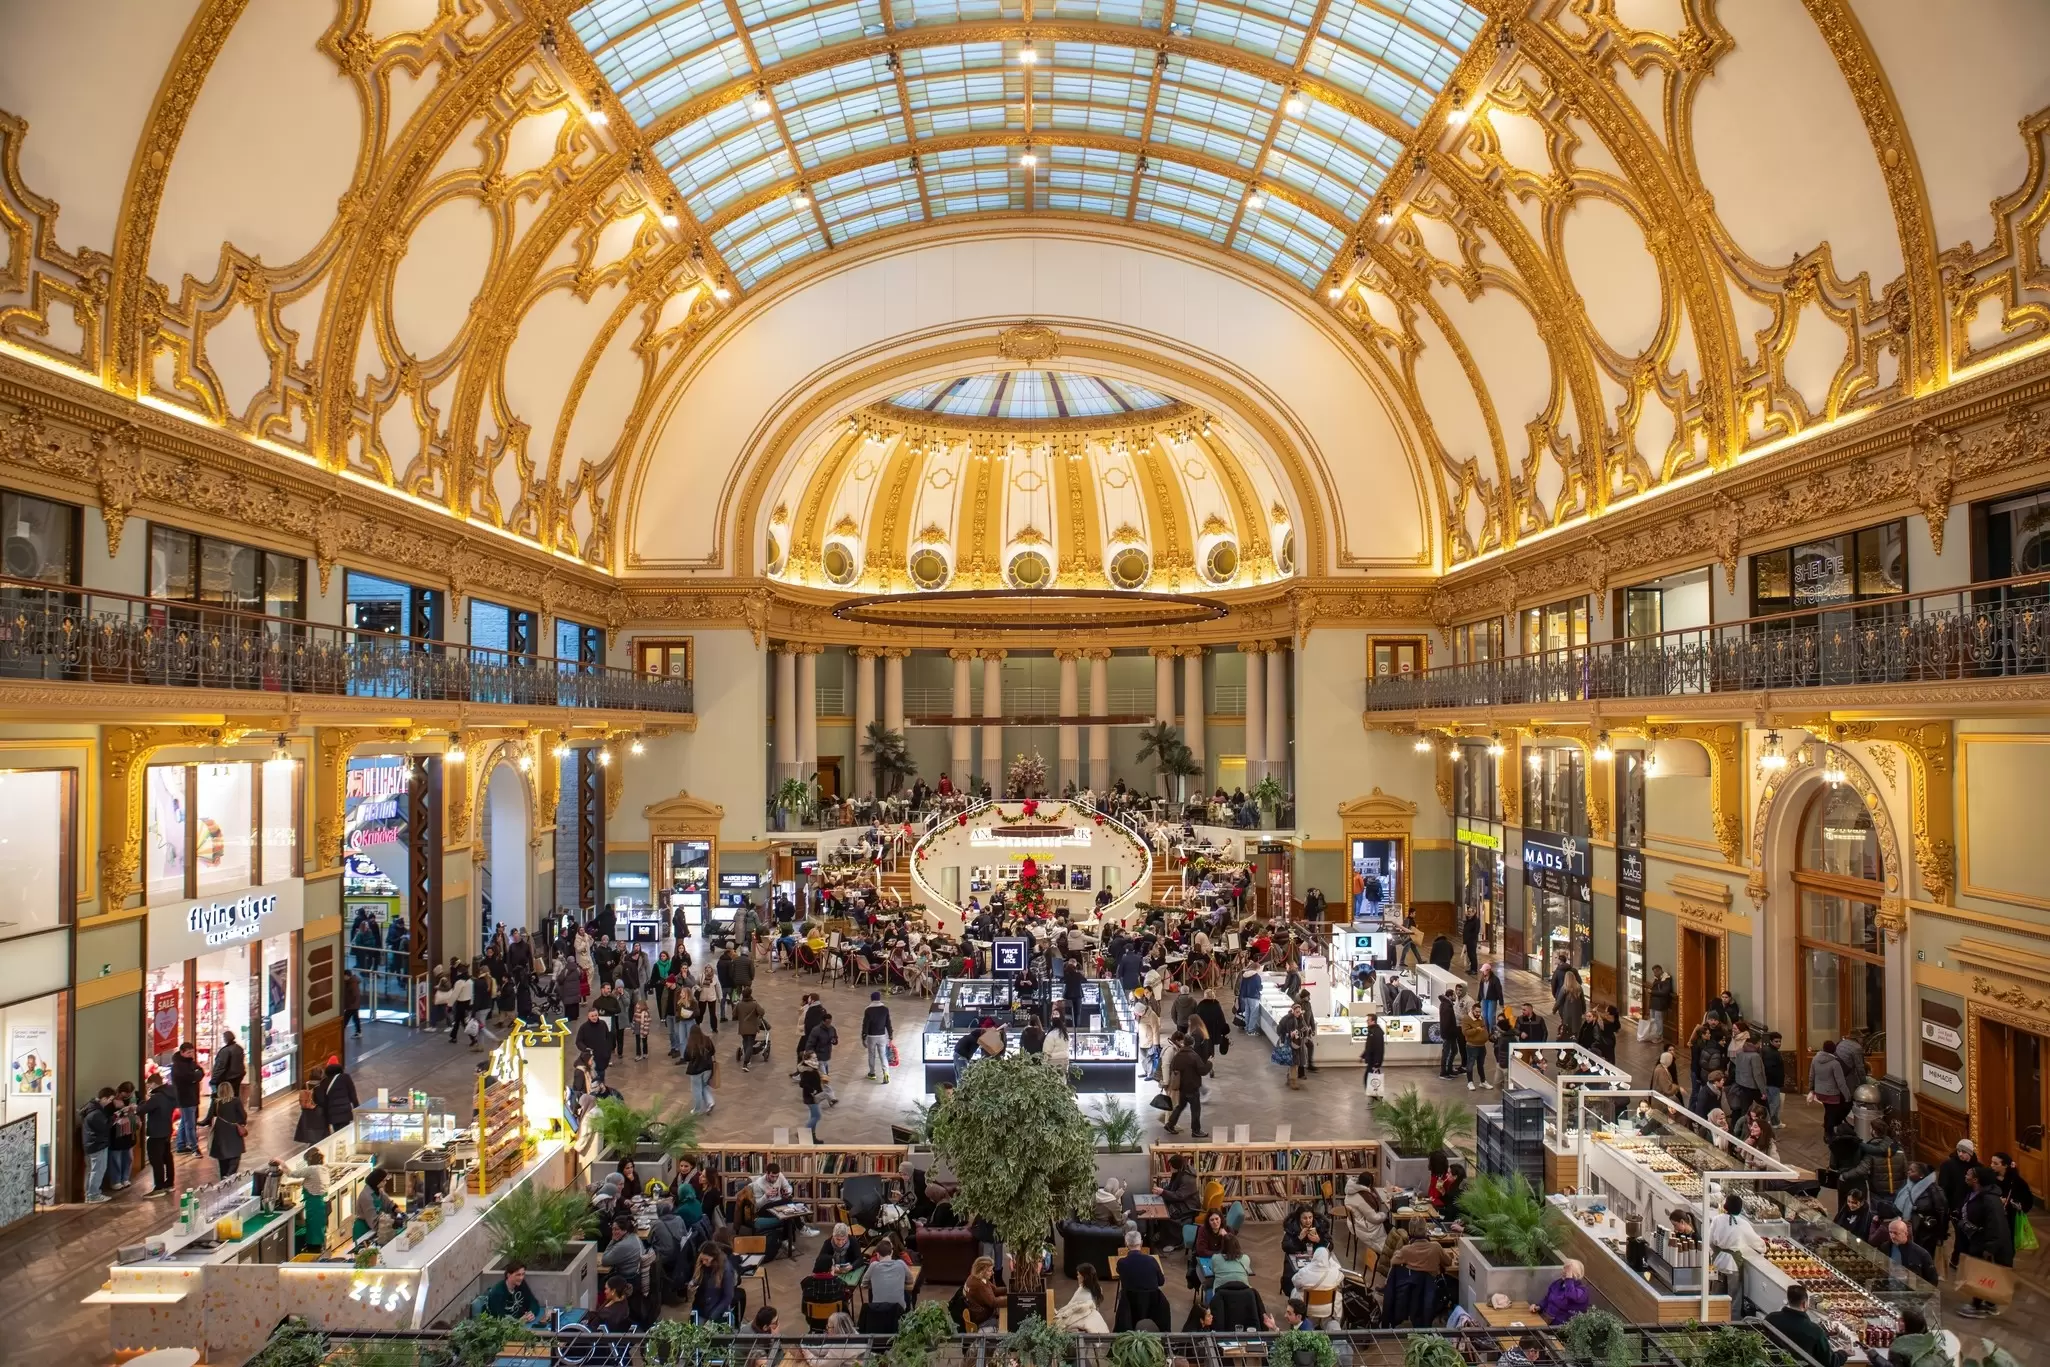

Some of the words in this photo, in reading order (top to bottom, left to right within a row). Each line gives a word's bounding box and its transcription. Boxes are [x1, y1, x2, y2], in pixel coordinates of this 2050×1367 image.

[1794, 555, 1844, 582] SHELFIE
[1794, 578, 1850, 606] STORAGE
[1525, 848, 1562, 869] MADS
[1623, 867, 1641, 879] MADS
[189, 903, 236, 933] flying
[240, 896, 277, 920] tiger
[158, 998, 175, 1011] SALE
